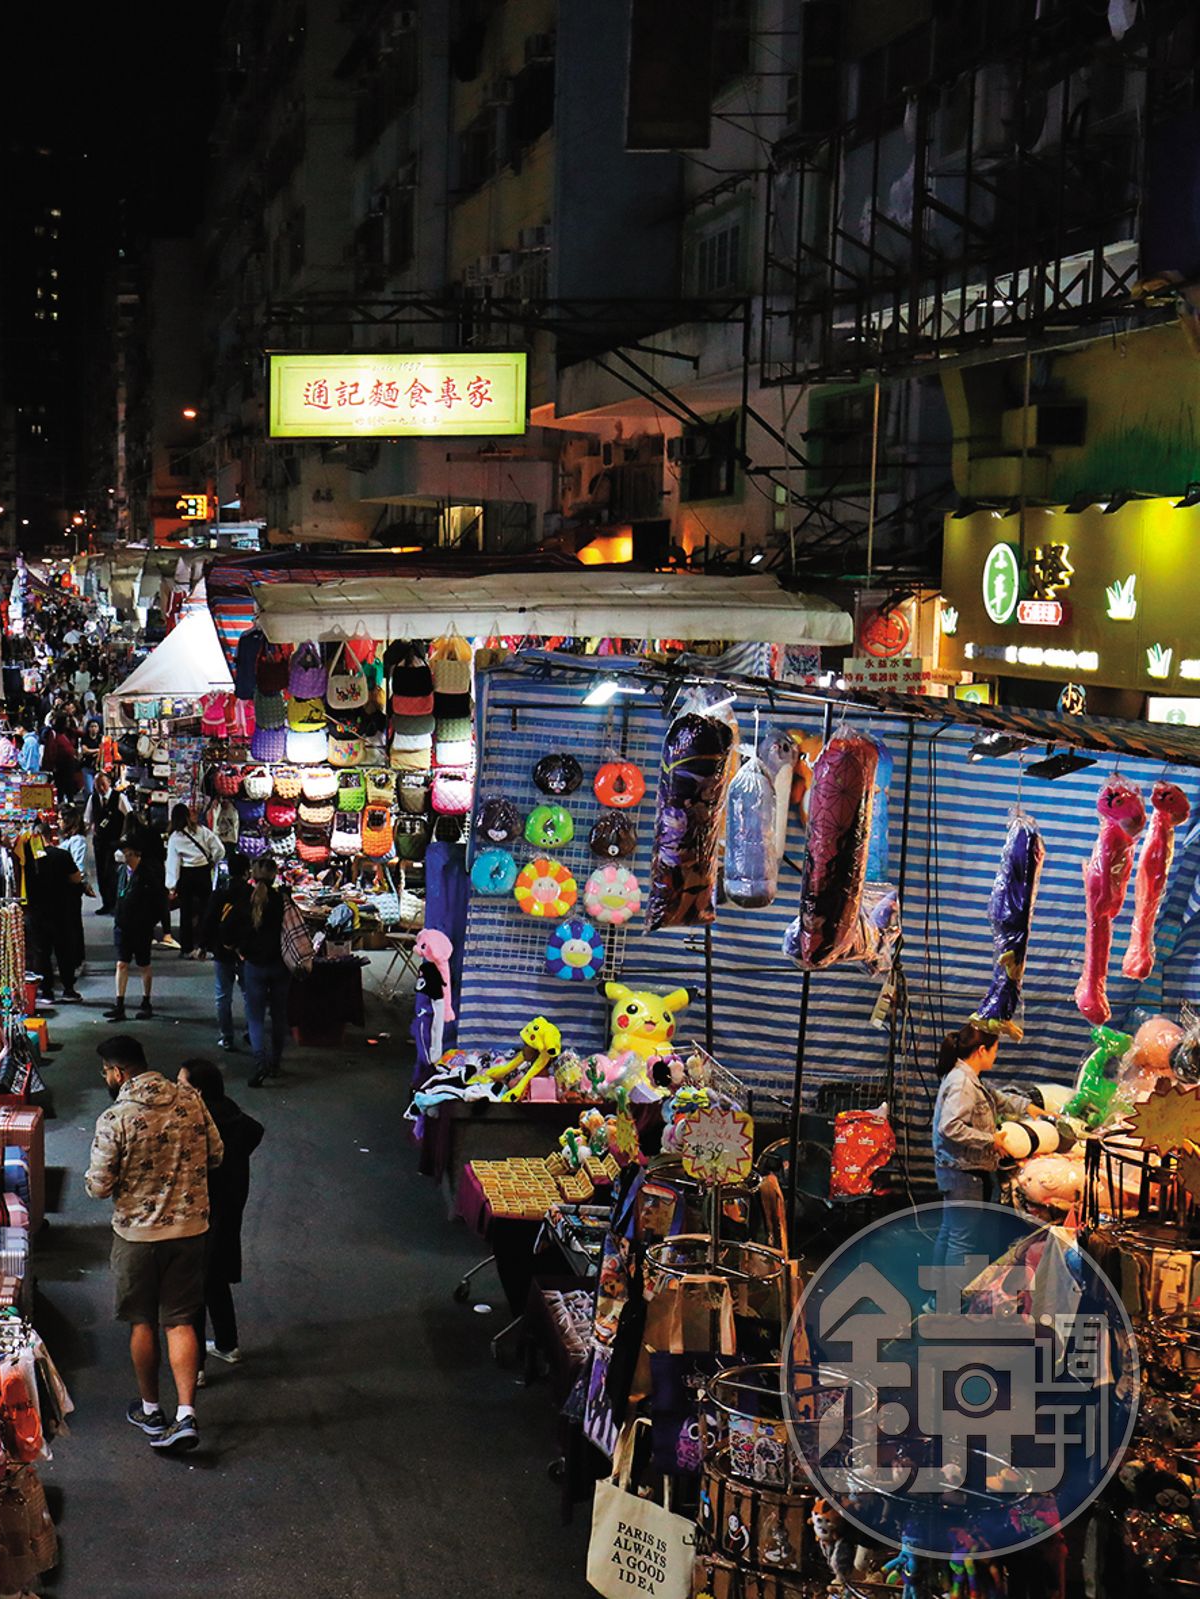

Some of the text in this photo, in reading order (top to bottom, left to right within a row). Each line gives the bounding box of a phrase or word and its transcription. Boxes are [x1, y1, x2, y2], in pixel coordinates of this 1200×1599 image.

[304, 375, 493, 410] 通記麵食專家
[613, 1536, 667, 1568] ALWAYS
[617, 1521, 667, 1553] PARIS IS
[611, 1551, 665, 1584] A GOOD
[618, 1569, 655, 1595] IDEA
